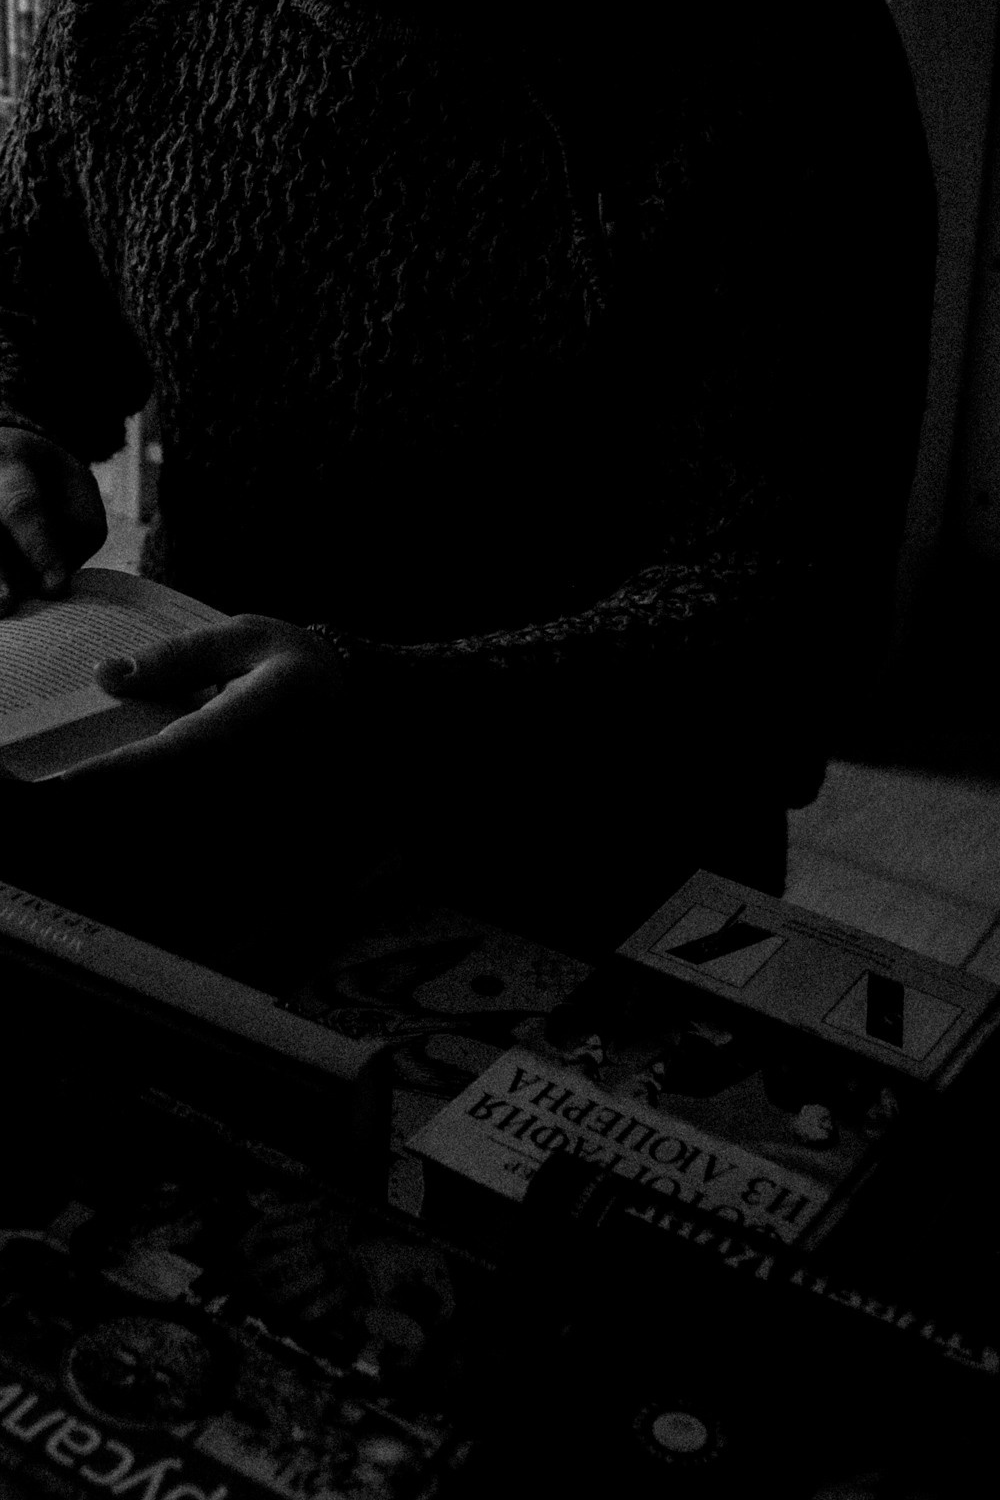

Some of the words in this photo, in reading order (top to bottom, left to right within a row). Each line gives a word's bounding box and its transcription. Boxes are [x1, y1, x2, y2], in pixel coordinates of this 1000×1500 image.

[502, 1065, 737, 1183] ЛЮЦЕРНА
[738, 1172, 812, 1223] ИЗ
[622, 1203, 774, 1282] Кинг
